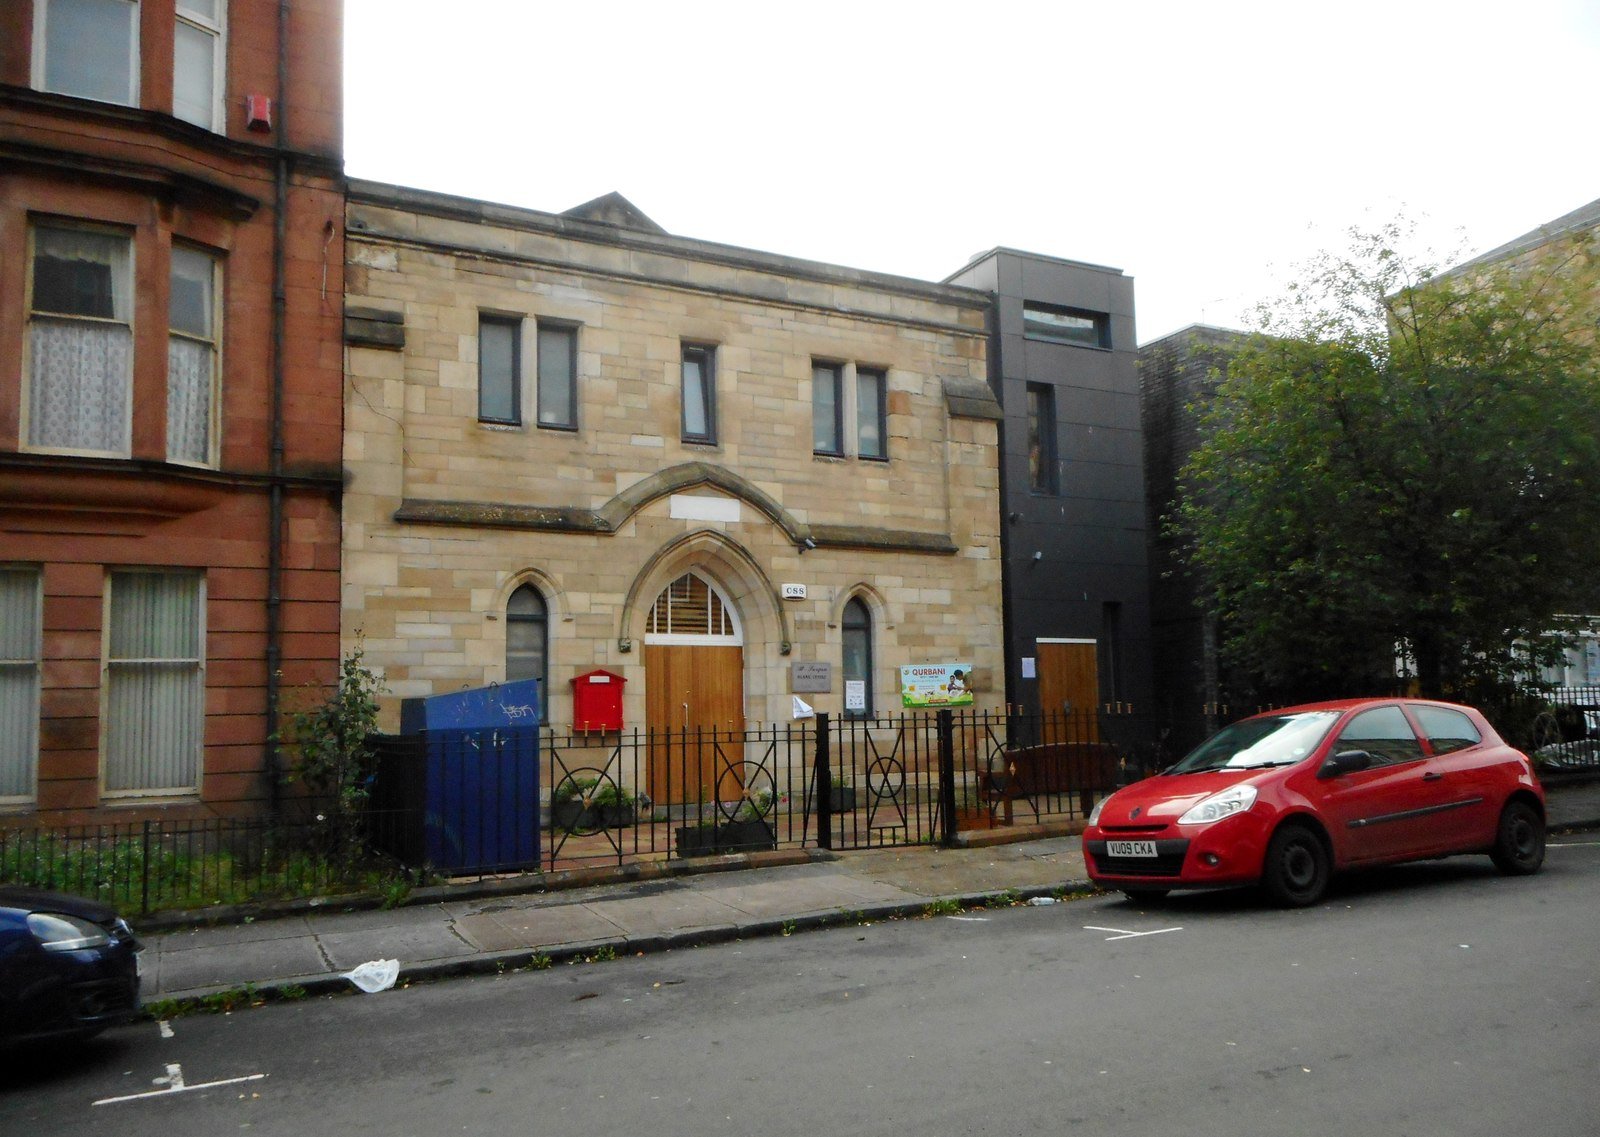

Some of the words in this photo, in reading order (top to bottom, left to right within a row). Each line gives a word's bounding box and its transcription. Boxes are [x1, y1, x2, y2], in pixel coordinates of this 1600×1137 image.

[912, 668, 946, 676] QURBANI
[1110, 842, 1133, 855] VU09
[1133, 842, 1154, 855] CKA
